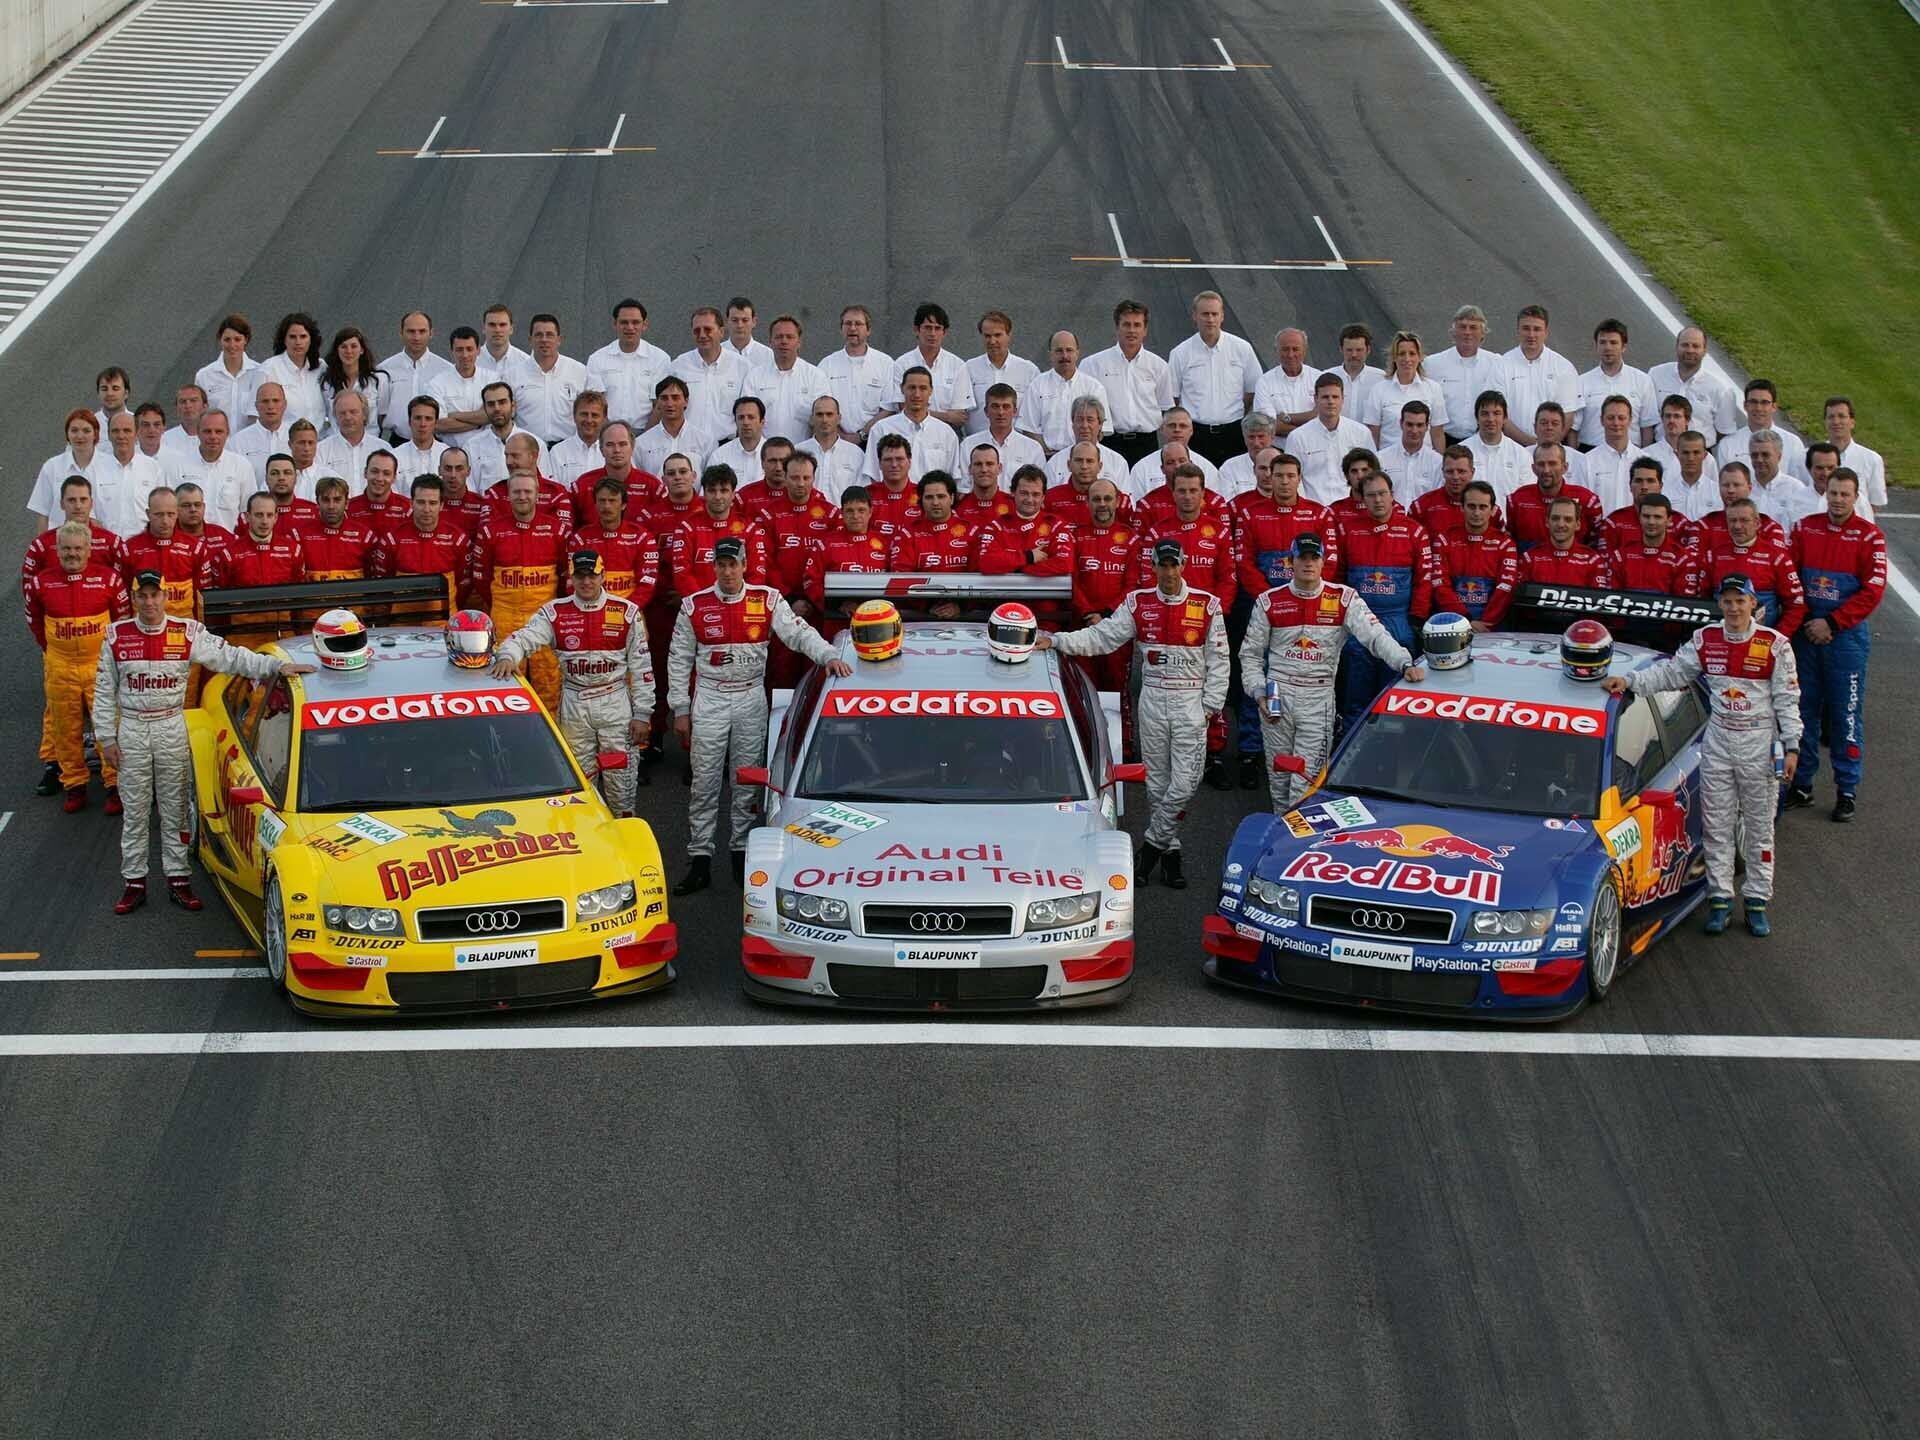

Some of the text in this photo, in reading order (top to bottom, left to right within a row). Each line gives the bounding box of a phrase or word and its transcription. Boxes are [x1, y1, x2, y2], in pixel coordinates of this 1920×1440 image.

[945, 555, 968, 565] line
[1104, 561, 1126, 572] line
[1191, 555, 1215, 565] line
[1361, 583, 1396, 595] Red Bull
[1536, 589, 1710, 623] PlayStation
[1284, 650, 1322, 662] Red Bull
[310, 694, 531, 726] vodafone
[835, 691, 1057, 716] vodafone
[1846, 672, 1859, 743] Audi Sport
[1386, 693, 1600, 734] vodafone
[819, 806, 878, 830] DEKRA
[1331, 799, 1365, 826] DEKRA
[343, 815, 398, 843] DEKRA
[806, 820, 844, 835] 44
[334, 832, 363, 847] 11
[792, 827, 832, 846] ADAC
[1612, 824, 1642, 857] DEKRA
[306, 837, 350, 858] ADAC
[875, 844, 1004, 861] Audi
[793, 866, 1083, 890] Original Teile
[1281, 851, 1499, 905] Red Bull
[644, 901, 663, 918] ABT
[1243, 905, 1299, 929] DUNLOP
[590, 908, 638, 933] DUNLOP
[290, 928, 317, 941] ABT
[784, 921, 849, 943] DUNLOP
[1040, 924, 1097, 944] DUNLOP
[334, 936, 406, 950] DUNLOP
[1473, 938, 1544, 953] DUNLOP
[1551, 937, 1579, 952] ABT
[354, 956, 383, 968] Castrol
[467, 948, 537, 963] BLAUPUNKT
[907, 951, 978, 961] BLAUPUNKT
[1343, 947, 1411, 964] BLAUPUNKT
[1502, 960, 1531, 971] Castrol
